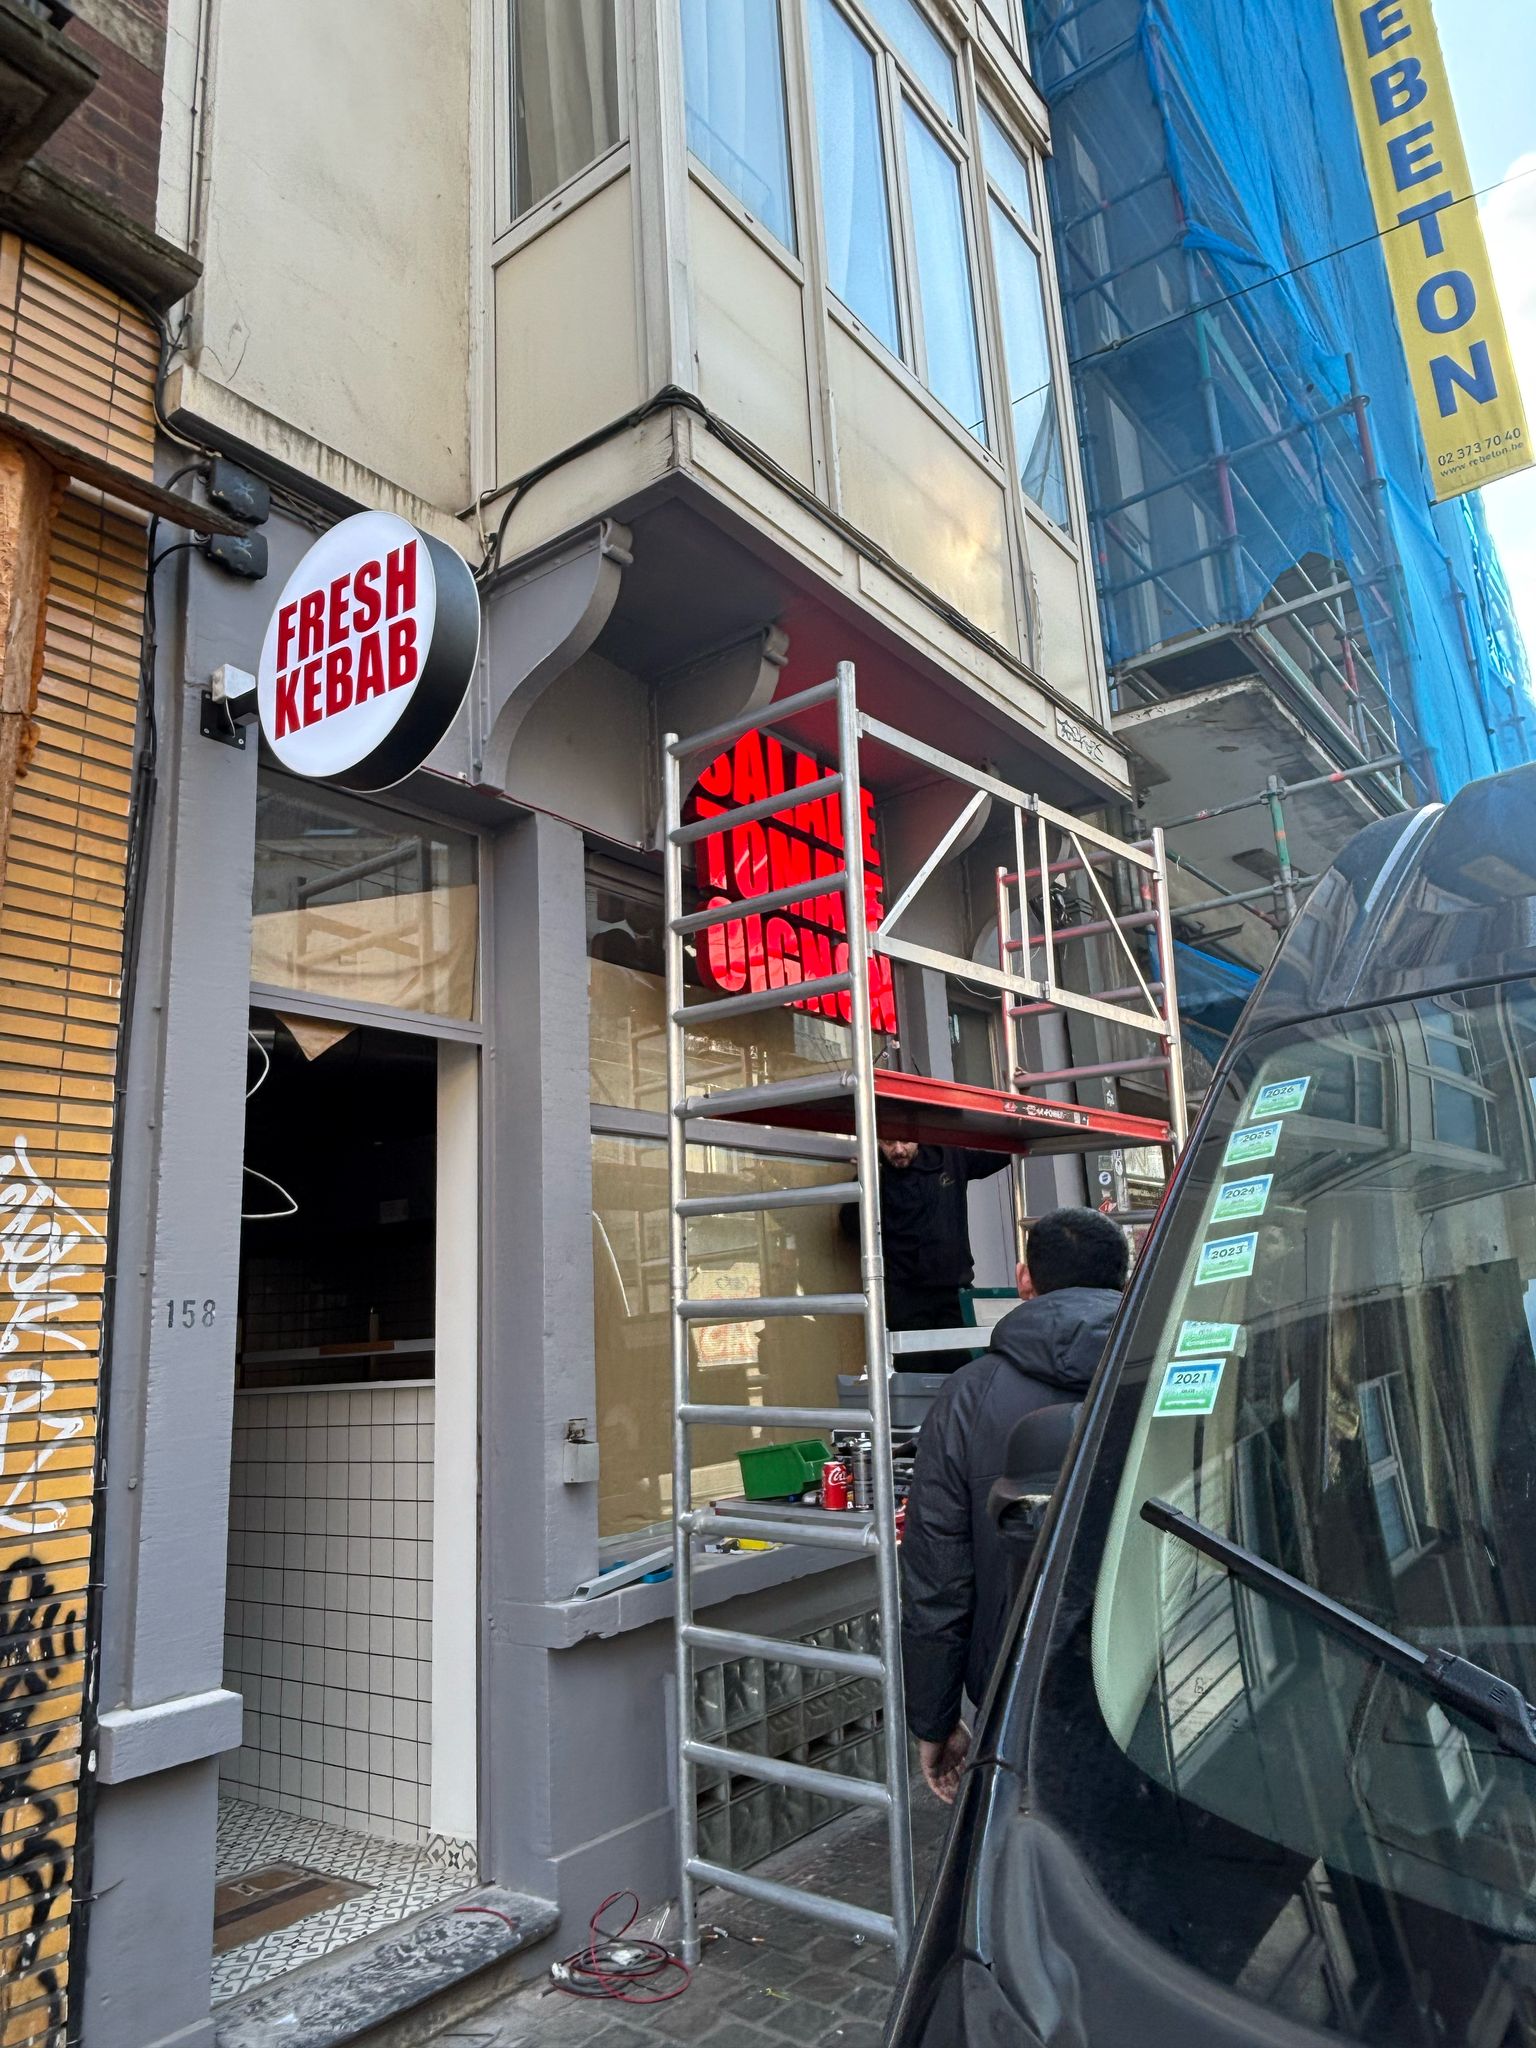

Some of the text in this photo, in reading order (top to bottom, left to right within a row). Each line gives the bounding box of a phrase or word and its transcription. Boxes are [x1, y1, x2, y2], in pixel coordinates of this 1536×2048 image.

[1438, 427, 1521, 466] 02 373 70 40
[1440, 442, 1524, 477] www.rebeton.be
[276, 539, 417, 673] FRESH
[275, 617, 418, 740] KEBAB
[696, 795, 884, 933] TOMAE
[1265, 1086, 1294, 1098] 2026
[1241, 1130, 1272, 1143] 2025
[1225, 1186, 1255, 1199] 2024
[1211, 1245, 1244, 1259] 2023
[166, 1299, 217, 1328] 158
[1174, 1372, 1208, 1385] 2021
